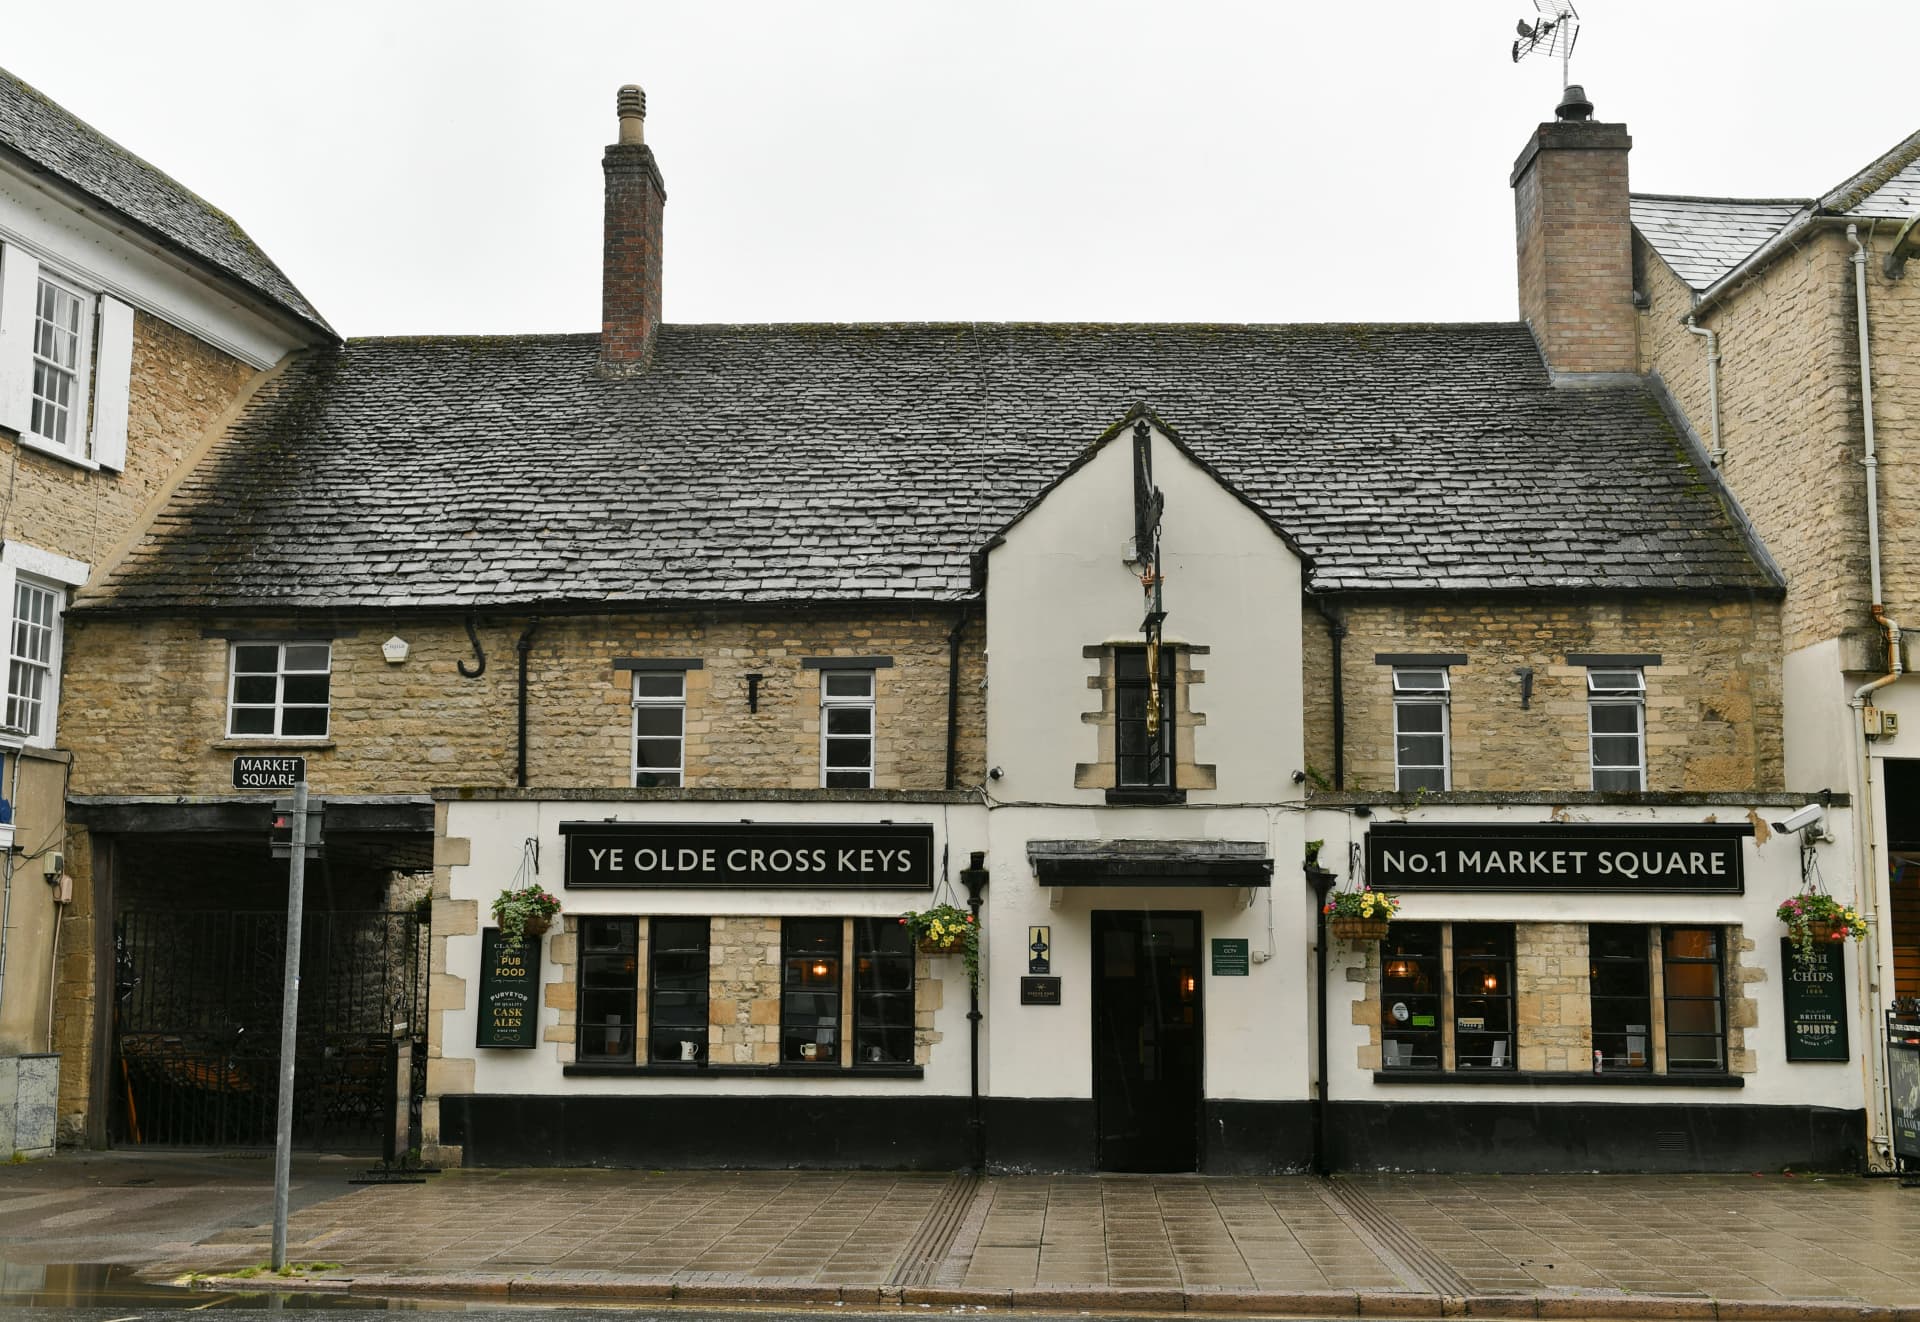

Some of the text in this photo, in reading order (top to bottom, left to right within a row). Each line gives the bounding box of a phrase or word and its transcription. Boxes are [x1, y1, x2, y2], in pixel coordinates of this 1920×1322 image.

[240, 760, 298, 771] MARKET
[242, 774, 296, 786] SQUARE
[588, 848, 911, 872] YE OLDE CROSS KEYS
[1383, 850, 1726, 879] No.1 MARKET SQUARE
[501, 957, 521, 965] PUB
[496, 968, 526, 976] FOOD
[1793, 972, 1834, 982] CHIPS
[493, 1008, 523, 1017] CASK
[493, 1018, 521, 1027] ALES
[1796, 1024, 1836, 1035] SPIRITS
